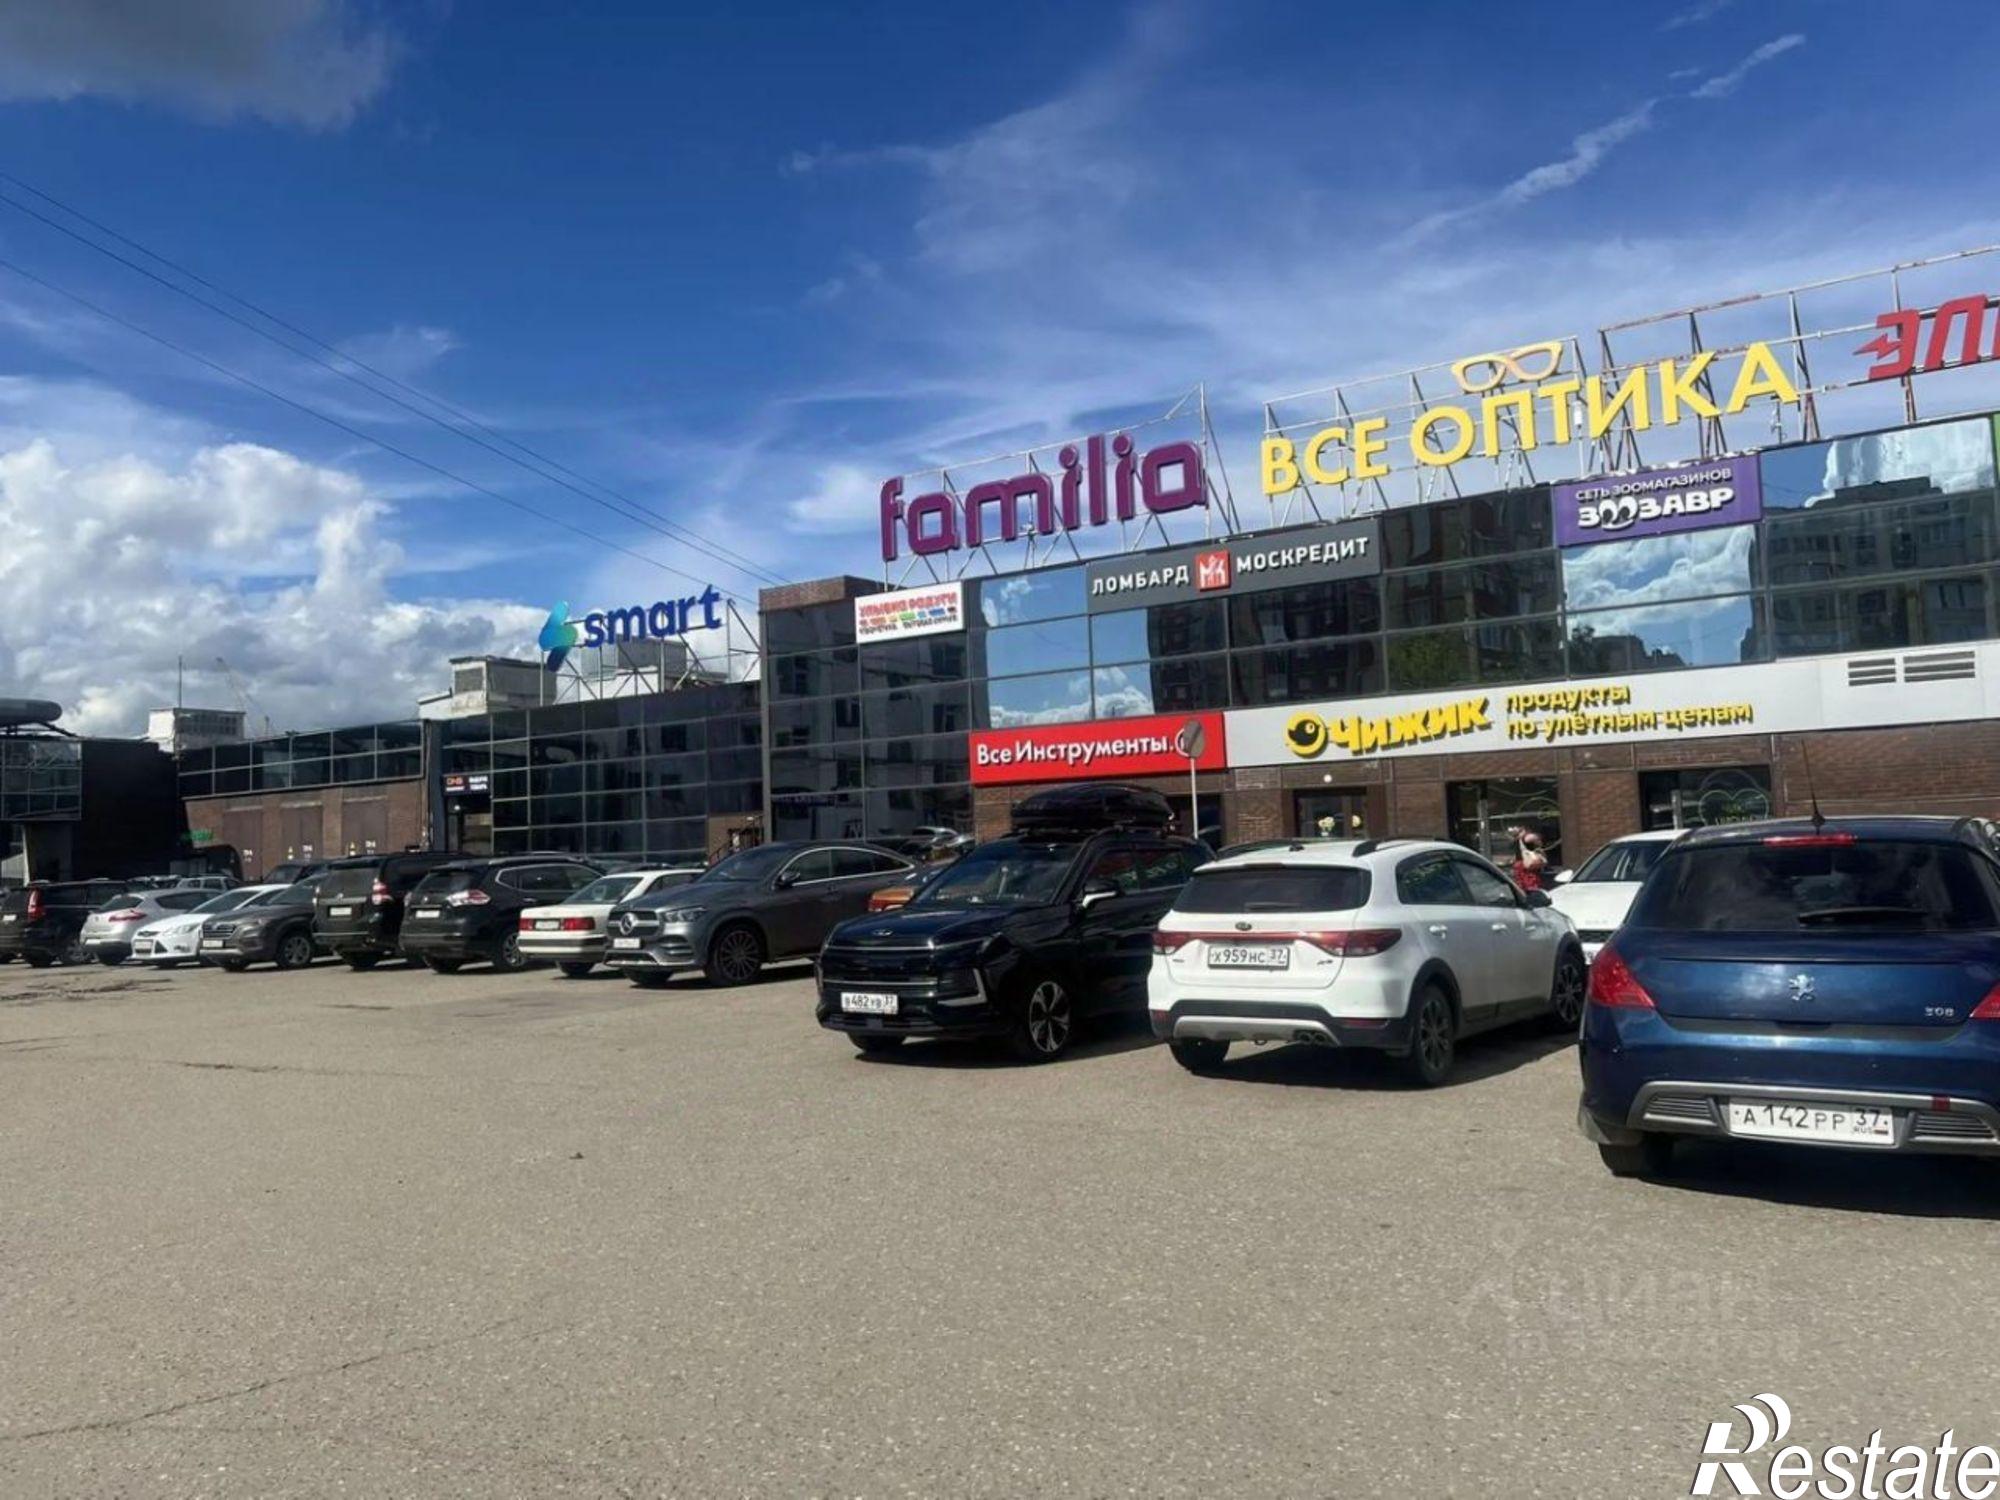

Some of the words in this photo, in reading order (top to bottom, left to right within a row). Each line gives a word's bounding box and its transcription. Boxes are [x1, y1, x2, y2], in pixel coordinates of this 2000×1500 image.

[1261, 416, 1389, 495] ВСЕ
[1409, 342, 1800, 466] ОПТИКА
[880, 433, 1207, 561] familia
[1575, 487, 1611, 502] СЕТЬ
[1613, 467, 1733, 496] ЗООМАГАЗИНОВ
[1577, 487, 1735, 531] ЗООЗАВР
[1091, 565, 1190, 596] ЛОМБАРД
[1236, 537, 1369, 574] МОСКРЕДИТ
[584, 584, 722, 648] smart
[1506, 684, 1630, 716] продукты
[1507, 717, 1538, 741] по
[1542, 708, 1659, 743] улётным
[1664, 702, 1753, 731] ценам
